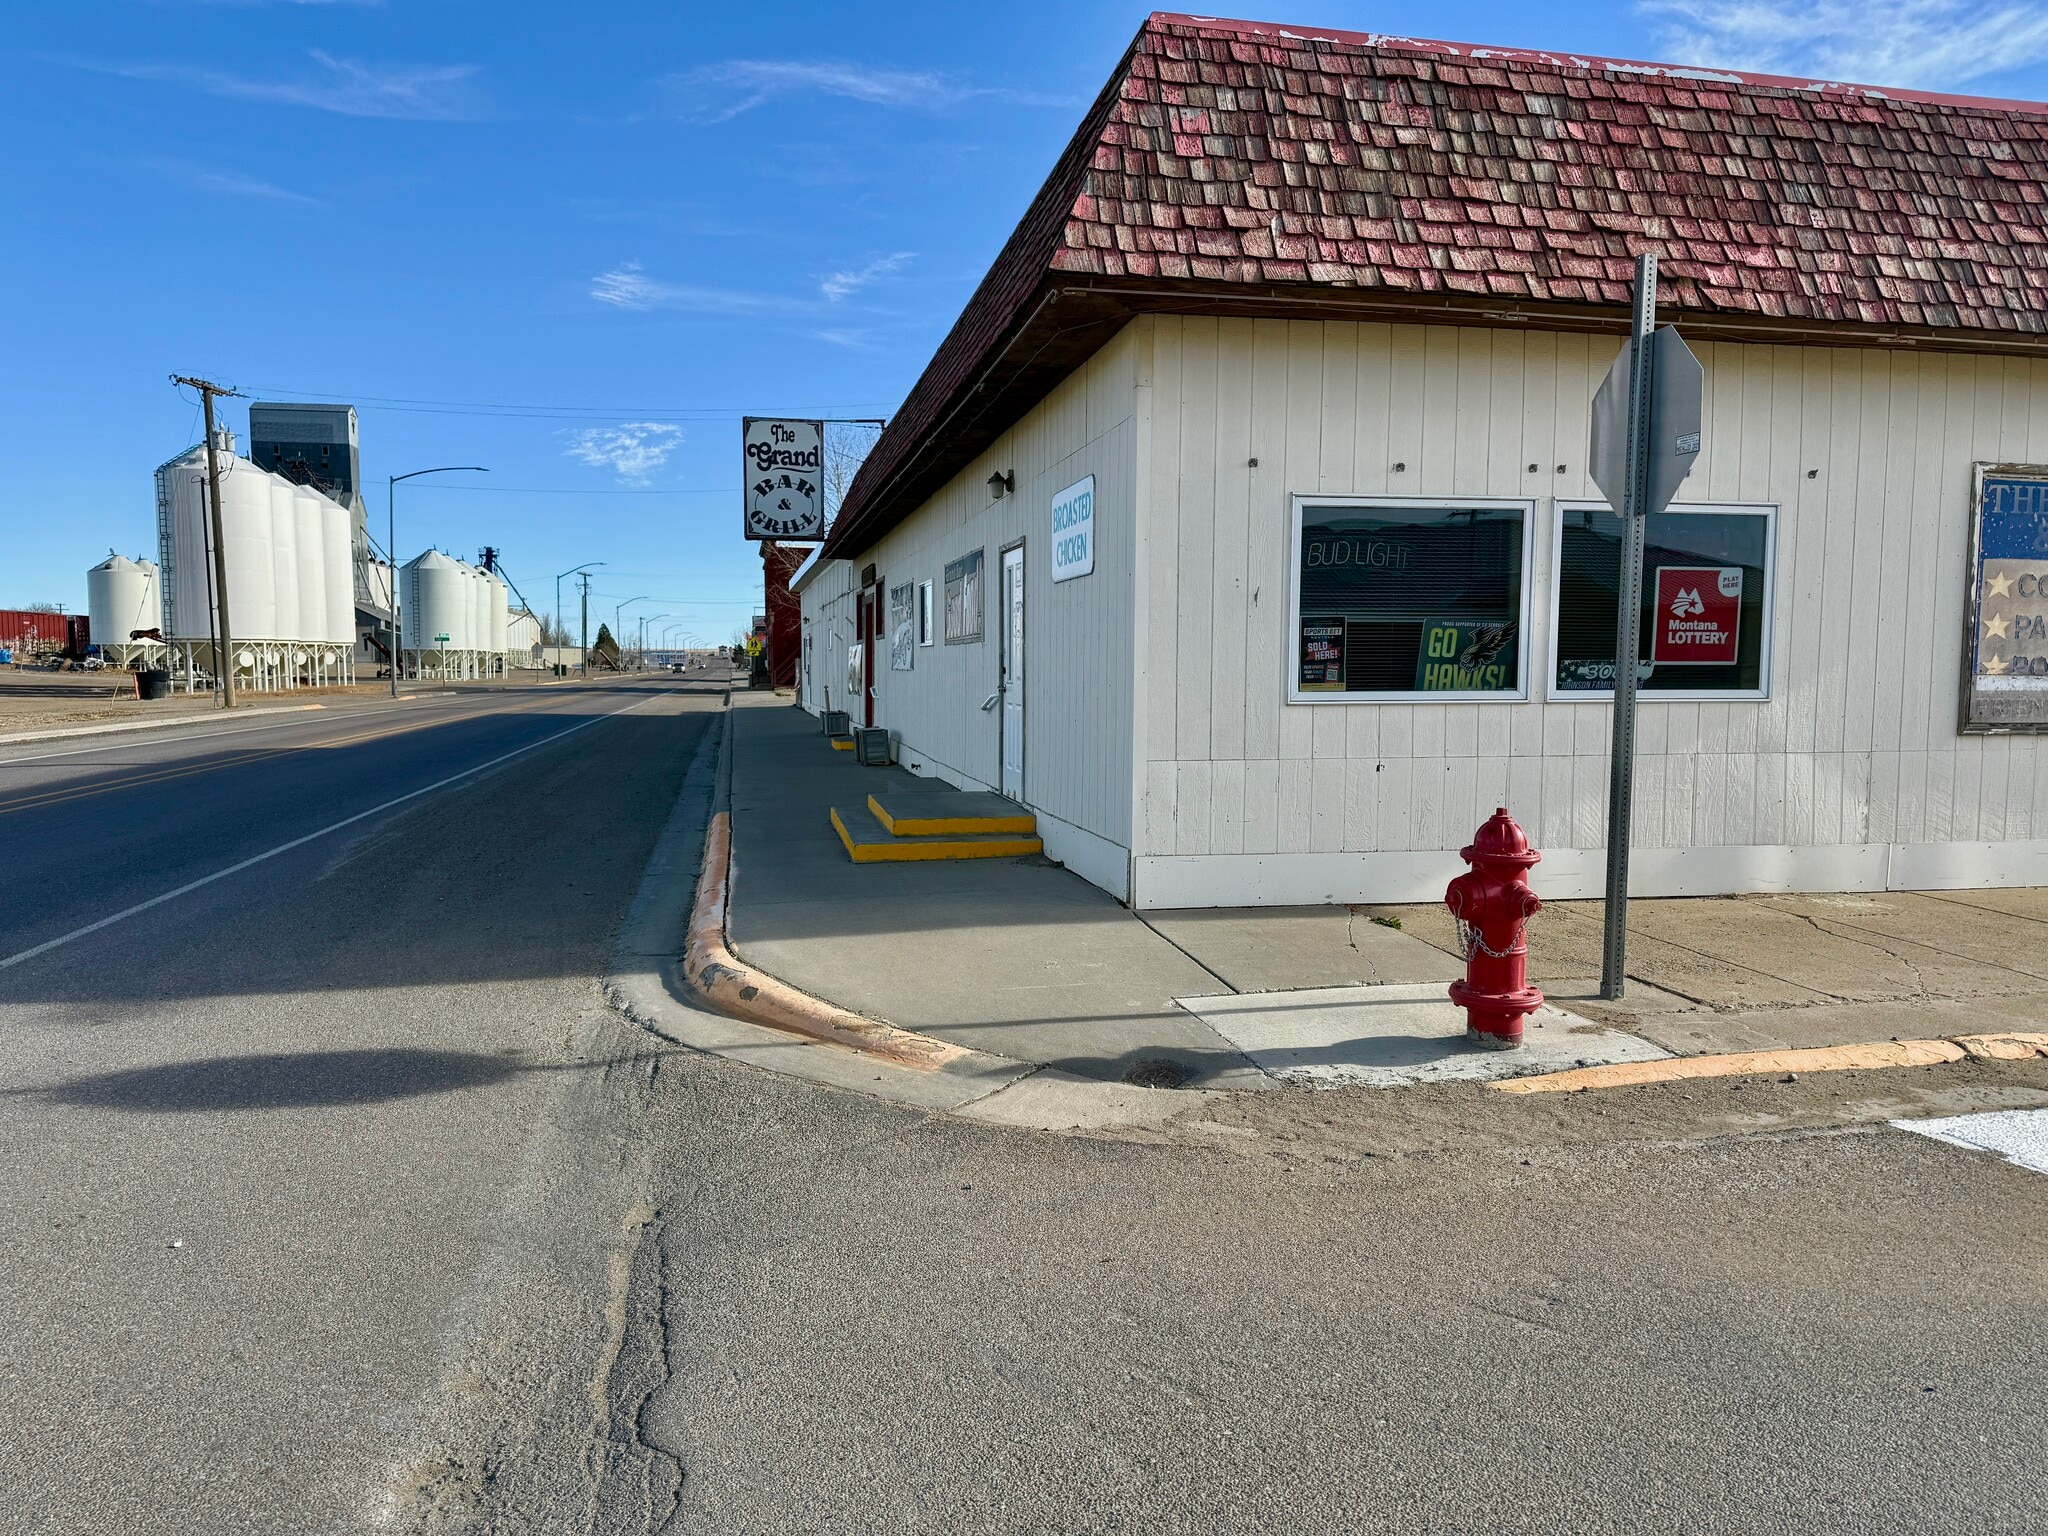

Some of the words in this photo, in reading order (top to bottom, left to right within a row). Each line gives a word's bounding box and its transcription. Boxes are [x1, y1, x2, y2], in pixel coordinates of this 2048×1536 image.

[770, 423, 795, 445] The
[747, 442, 820, 471] Grand
[753, 474, 816, 498] BAR
[777, 498, 792, 510] &
[1053, 491, 1091, 534] BROASTED
[750, 510, 817, 534] GRILL
[1056, 532, 1087, 568] CHICKEN
[1307, 541, 1351, 566] BUD
[1355, 541, 1411, 569] LIGHT
[1722, 575, 1740, 583] PLAY
[1668, 619, 1718, 630] Montana
[1307, 641, 1328, 652] SOLD
[1427, 628, 1458, 658] GO
[1668, 632, 1728, 644] LOTTERY
[1314, 649, 1338, 661] HERE!
[1423, 663, 1506, 691] HAWKS!
[1591, 680, 1615, 689] FAMILY
